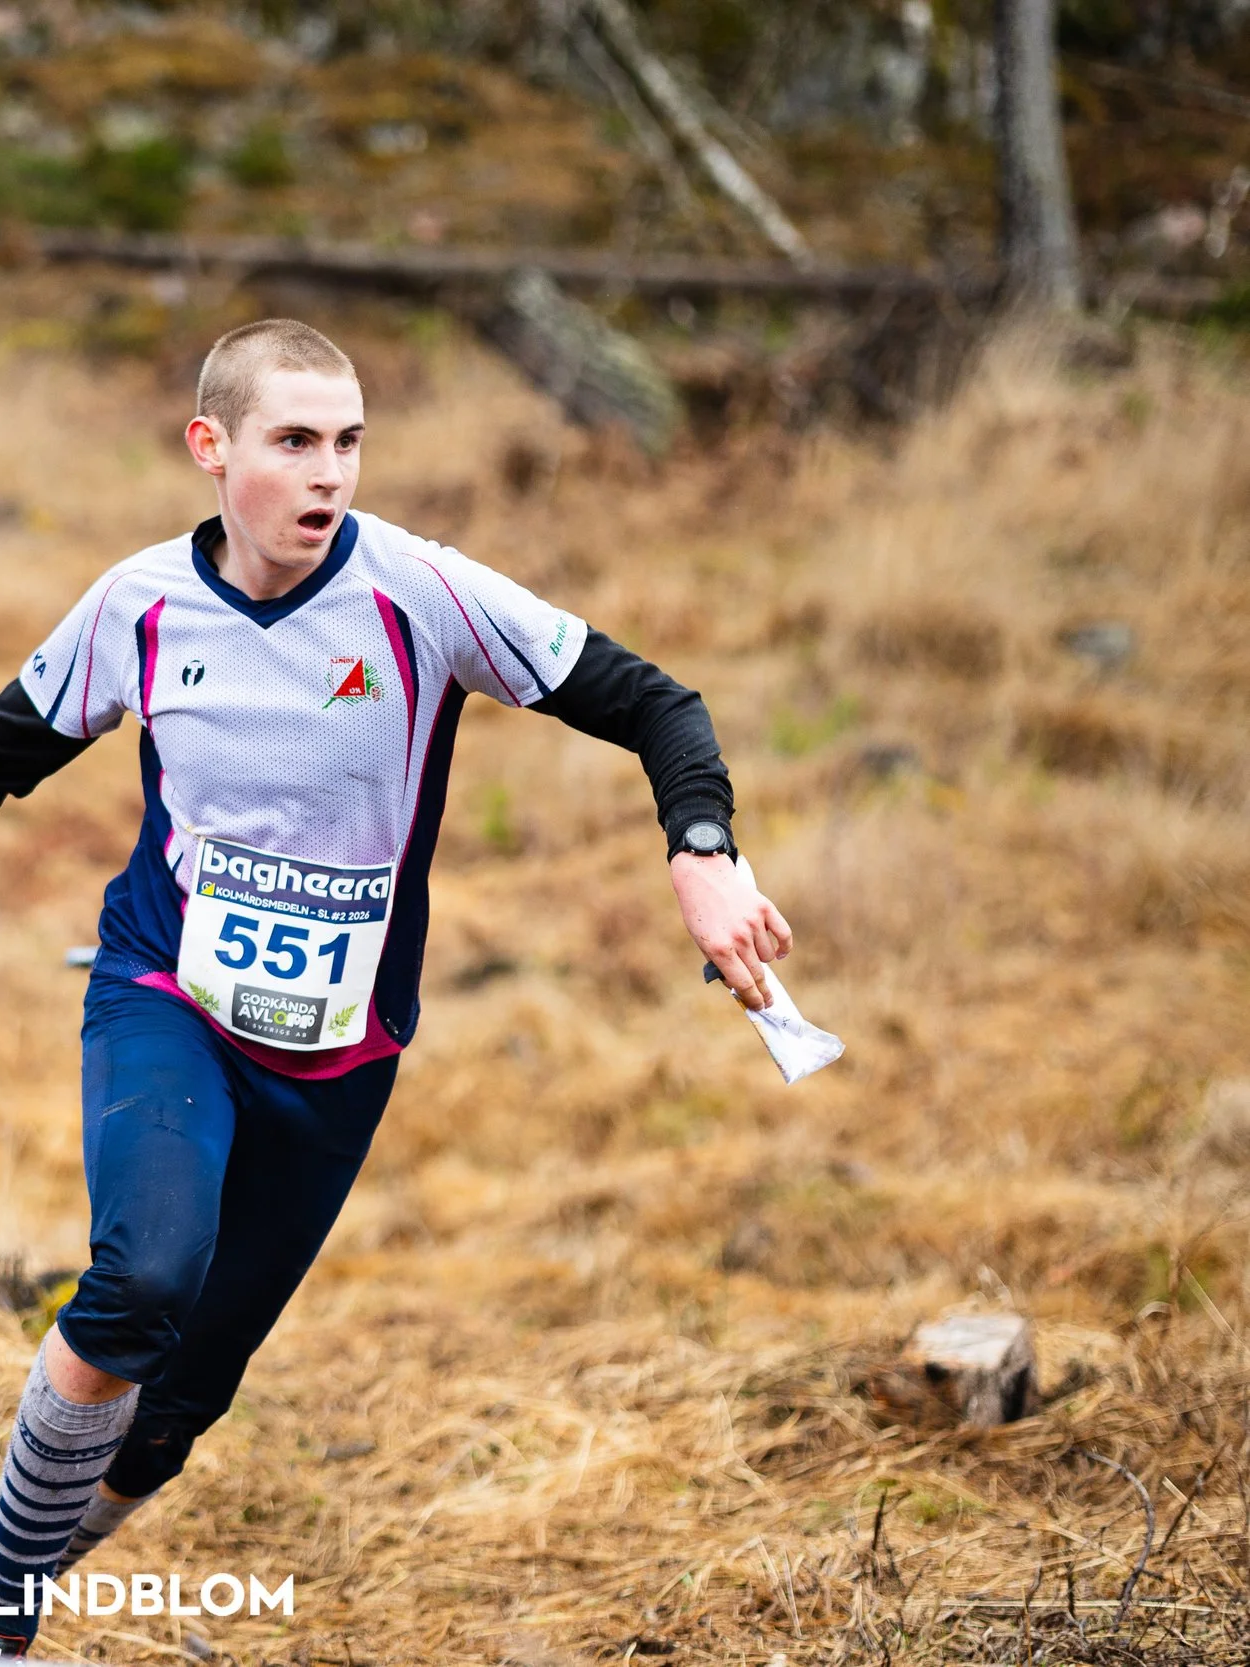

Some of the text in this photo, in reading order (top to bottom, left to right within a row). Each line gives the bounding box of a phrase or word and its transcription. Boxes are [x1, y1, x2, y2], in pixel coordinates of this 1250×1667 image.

[201, 843, 390, 901] bagheera
[215, 887, 310, 916] KOLMÅRDSMEDELN
[317, 908, 330, 920] SL
[331, 912, 346, 921] #2
[347, 910, 370, 921] 2026
[214, 912, 351, 985] 551
[240, 992, 318, 1015] GODKÄNDA
[252, 1023, 291, 1036] SVERIGE
